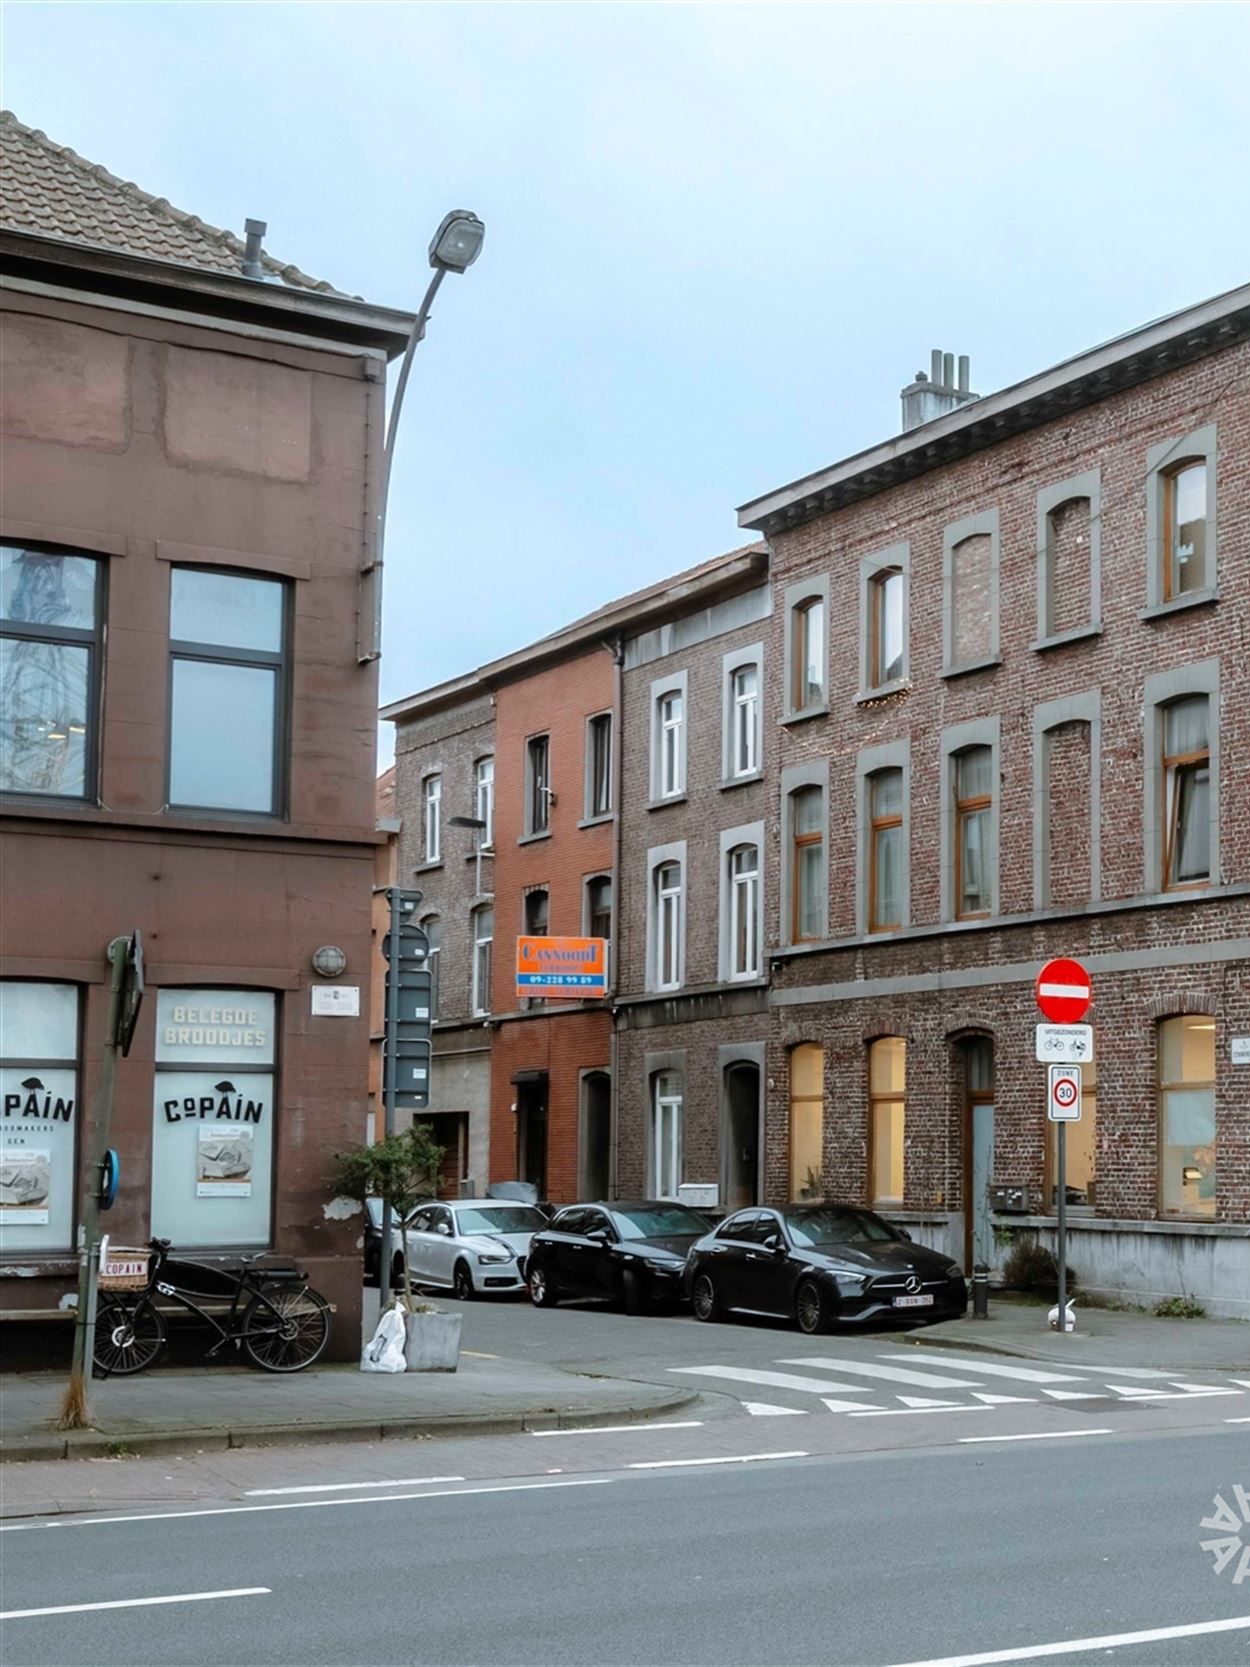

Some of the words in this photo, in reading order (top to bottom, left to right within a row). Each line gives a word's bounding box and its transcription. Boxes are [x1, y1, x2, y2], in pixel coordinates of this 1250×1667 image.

[165, 1027, 266, 1046] BROODJES
[1045, 1028, 1087, 1036] UITGEZONDERD
[1059, 1087, 1072, 1098] 30
[106, 1263, 143, 1274] COPAIN
